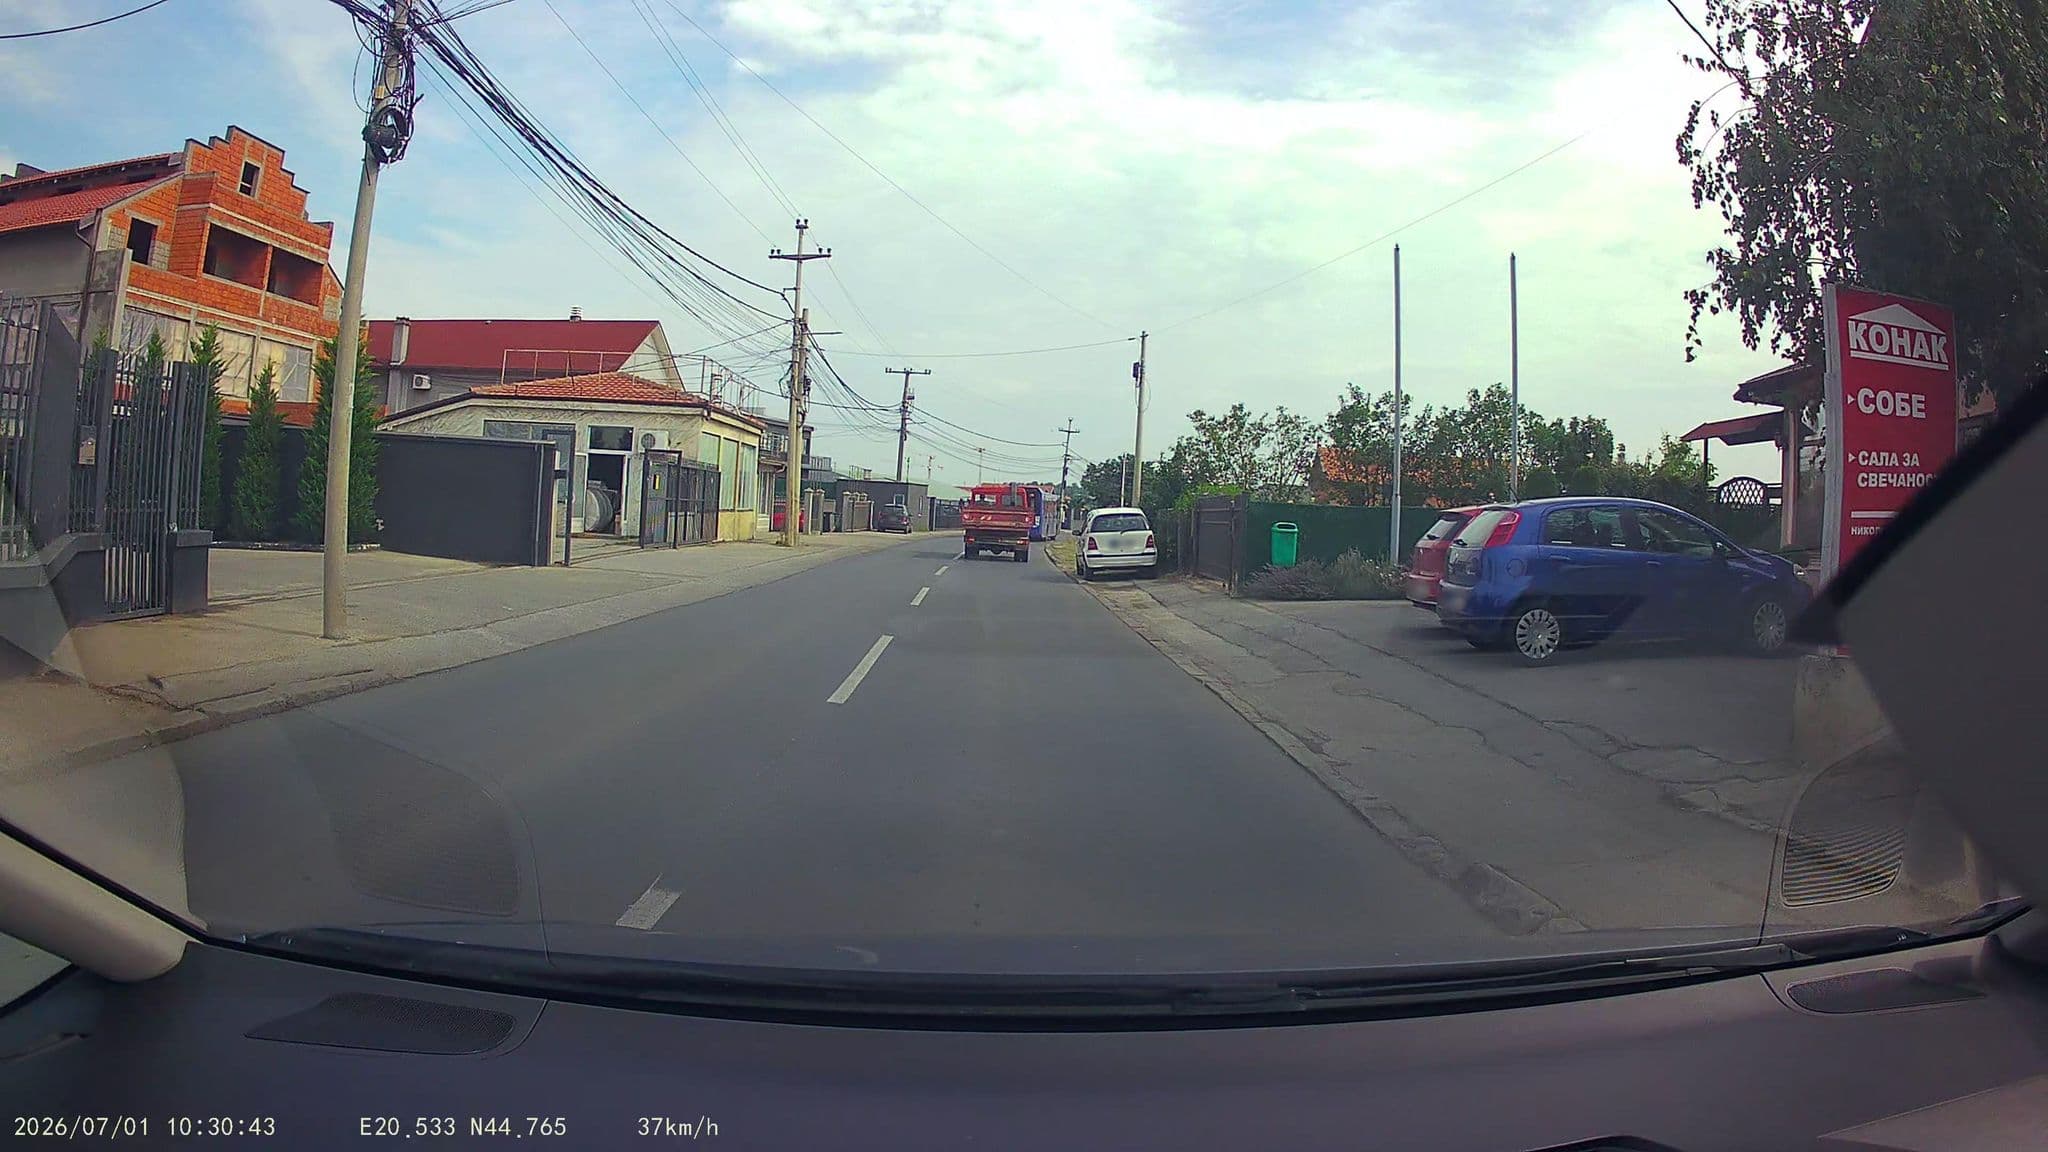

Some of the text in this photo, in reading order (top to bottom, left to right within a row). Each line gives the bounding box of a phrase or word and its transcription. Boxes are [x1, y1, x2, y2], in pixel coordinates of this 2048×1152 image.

[1848, 320, 1948, 363] КОНАК
[1857, 388, 1926, 418] СОБЕ
[1858, 451, 1920, 466] САЛА ЗА
[1857, 472, 1936, 487] СВЕЧАНОС
